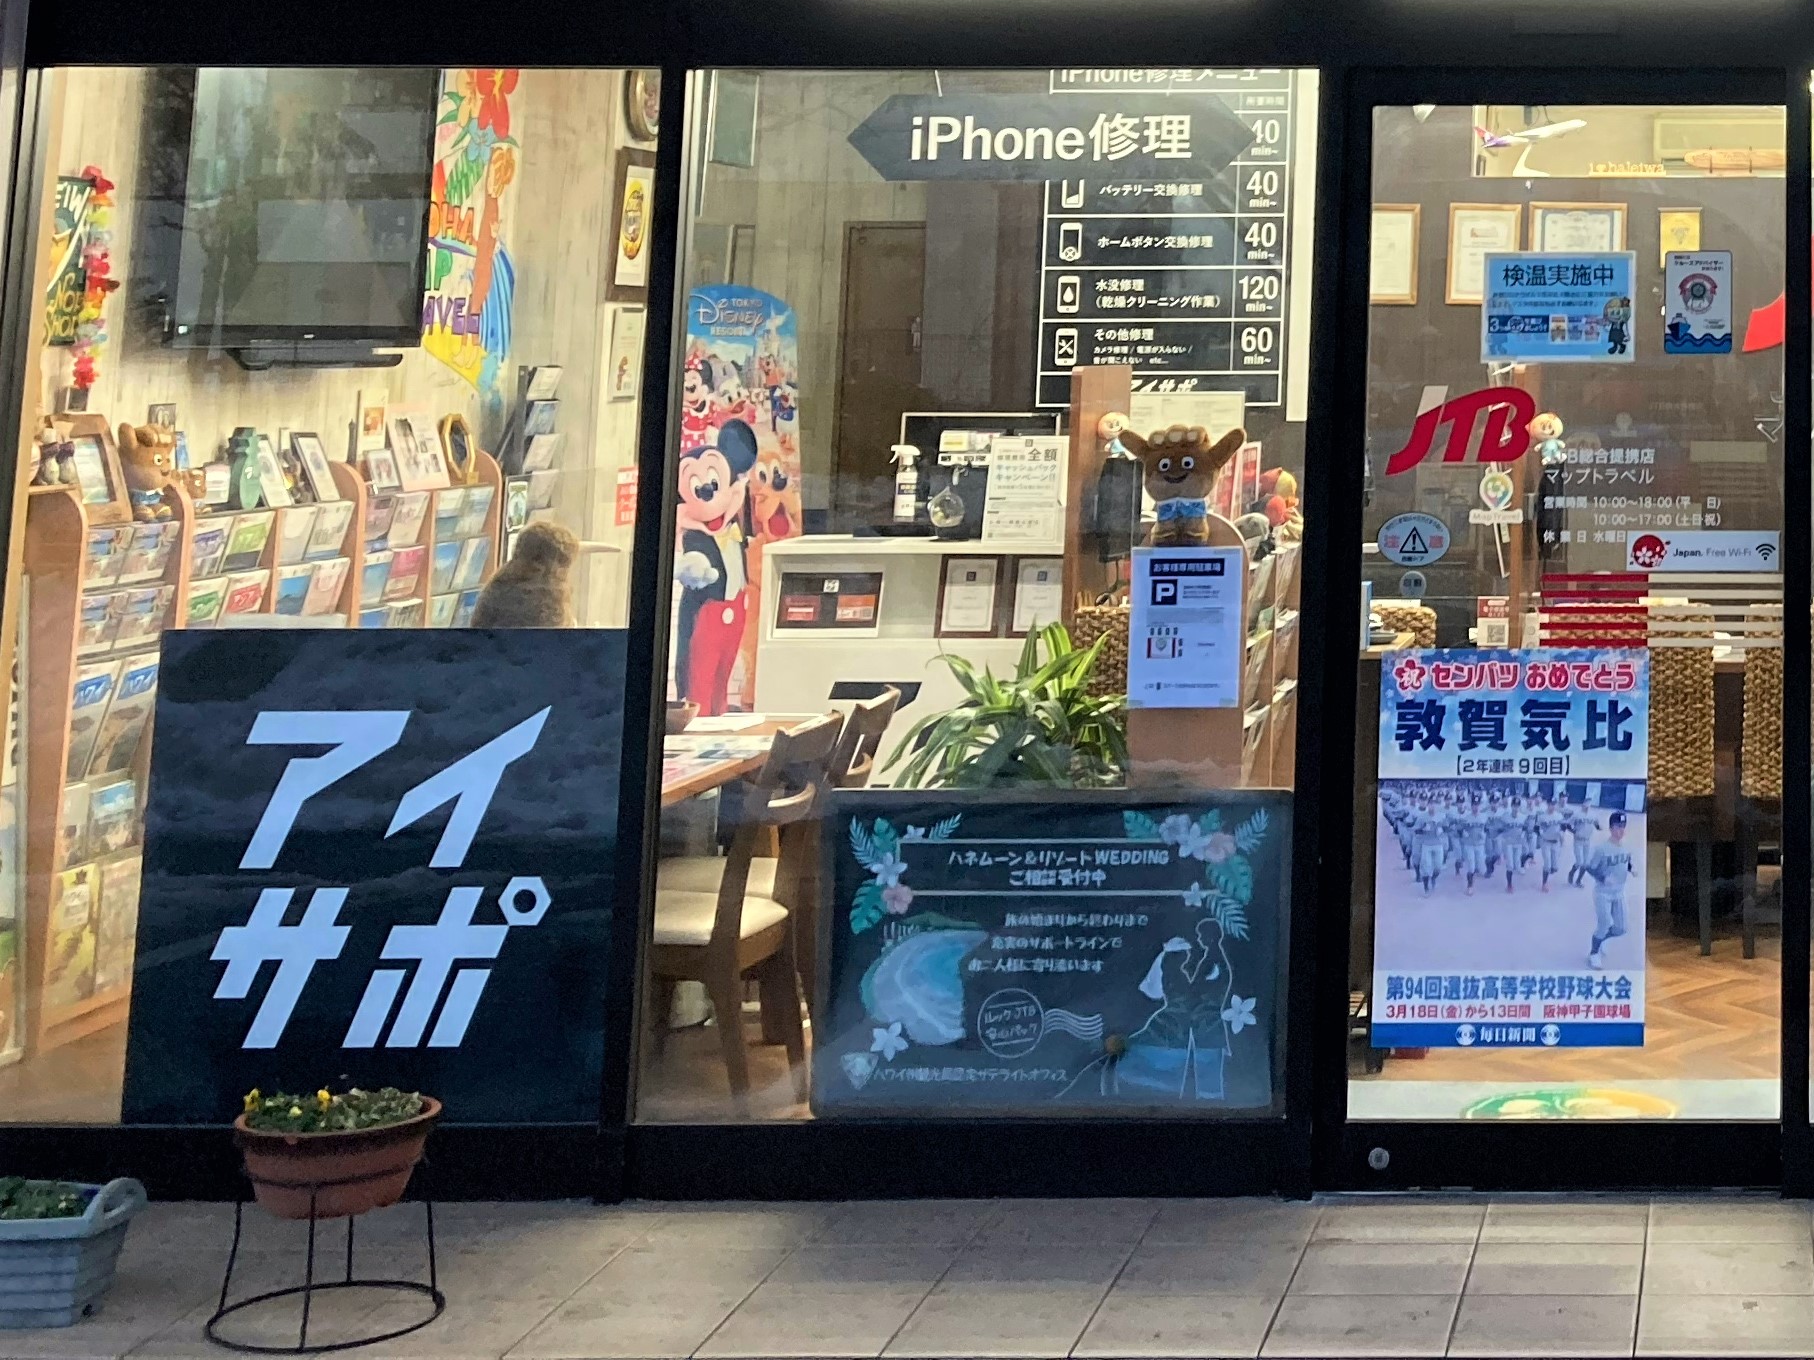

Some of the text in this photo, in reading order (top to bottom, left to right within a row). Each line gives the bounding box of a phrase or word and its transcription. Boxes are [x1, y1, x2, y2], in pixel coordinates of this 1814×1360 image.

[910, 113, 1193, 161] iPhone修理
[1251, 119, 1280, 144] 40
[1100, 171, 1279, 197] バッテリー交換修理 40
[1098, 222, 1277, 249] ホームボタン交換修理 40
[1502, 263, 1615, 287] 検温実施中
[1095, 276, 1279, 300] 水没修理 120
[1094, 327, 1273, 353] その他修理 60
[1386, 386, 1536, 475] JTB
[1027, 448, 1058, 462] 全額
[1547, 448, 1655, 465] B総合提携店
[1545, 468, 1655, 485] マップトラベル
[1543, 496, 1588, 509] 営業時間
[1593, 530, 1627, 543] 水曜日
[1706, 548, 1726, 557] Free
[1155, 583, 1175, 602] P
[1432, 662, 1518, 689] センバツ
[1525, 662, 1635, 690] おめでとう
[1395, 699, 1633, 752] 敦賀気比
[239, 706, 551, 869] アイ
[209, 876, 551, 1048] サポ
[1386, 975, 1632, 1001] 第94回選抜高等学校野球大会
[1543, 1004, 1631, 1020] 阪神甲子園球場
[1480, 1026, 1536, 1043] 毎日新聞
